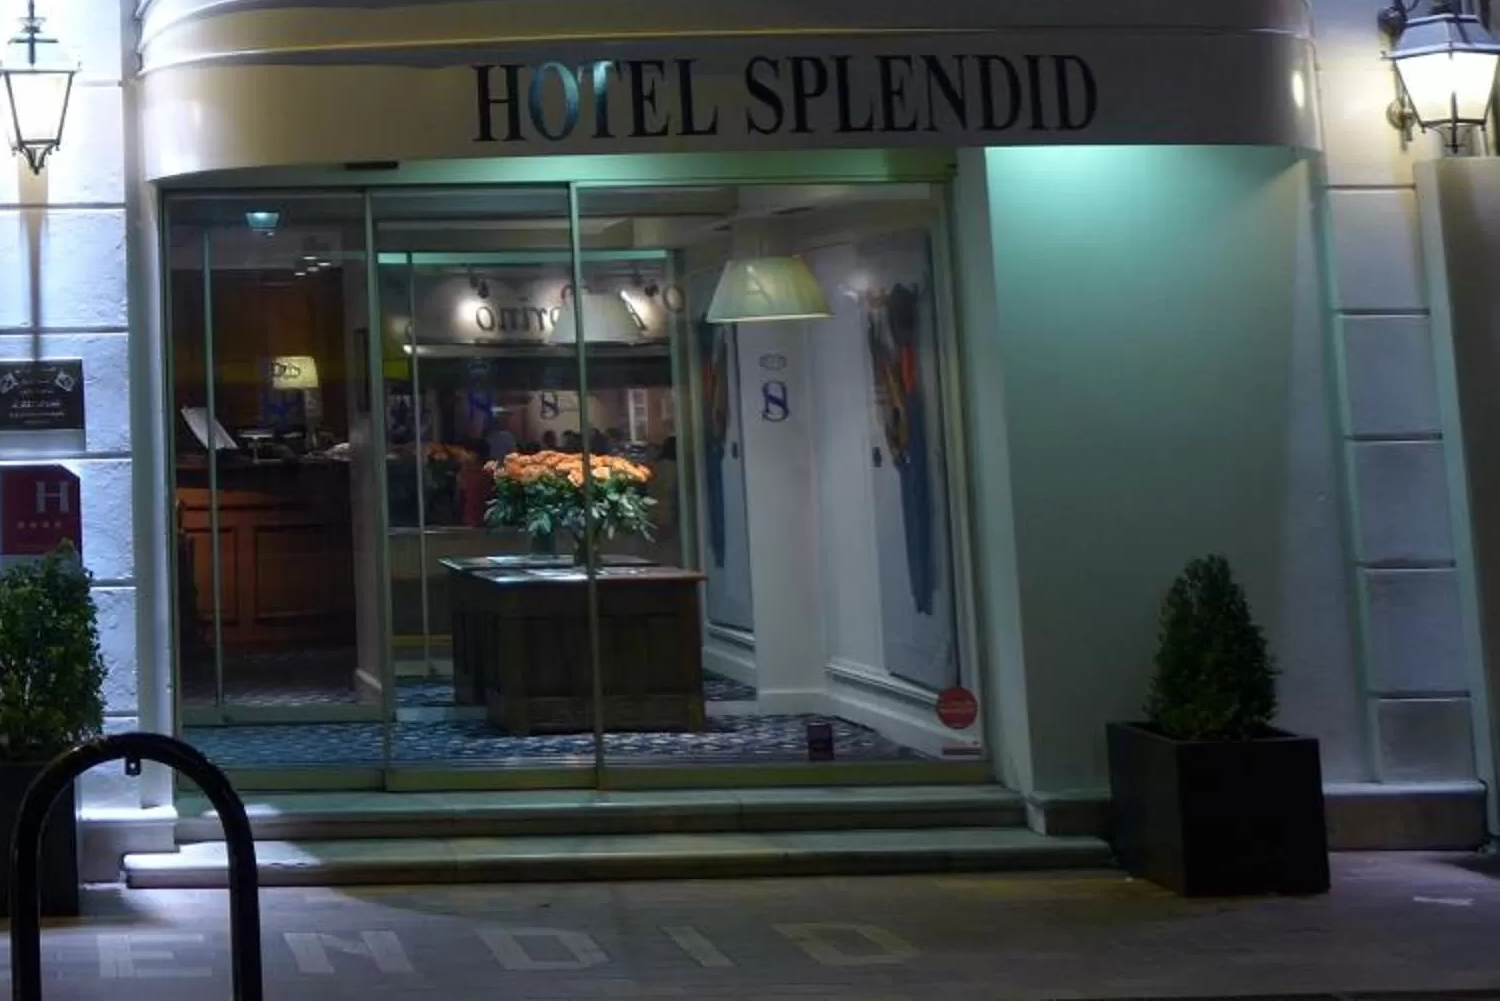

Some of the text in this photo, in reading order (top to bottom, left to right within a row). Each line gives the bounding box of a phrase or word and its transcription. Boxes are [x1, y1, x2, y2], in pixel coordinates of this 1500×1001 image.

[470, 54, 1098, 143] HOTEL SPLENDID
[35, 480, 69, 514] H
